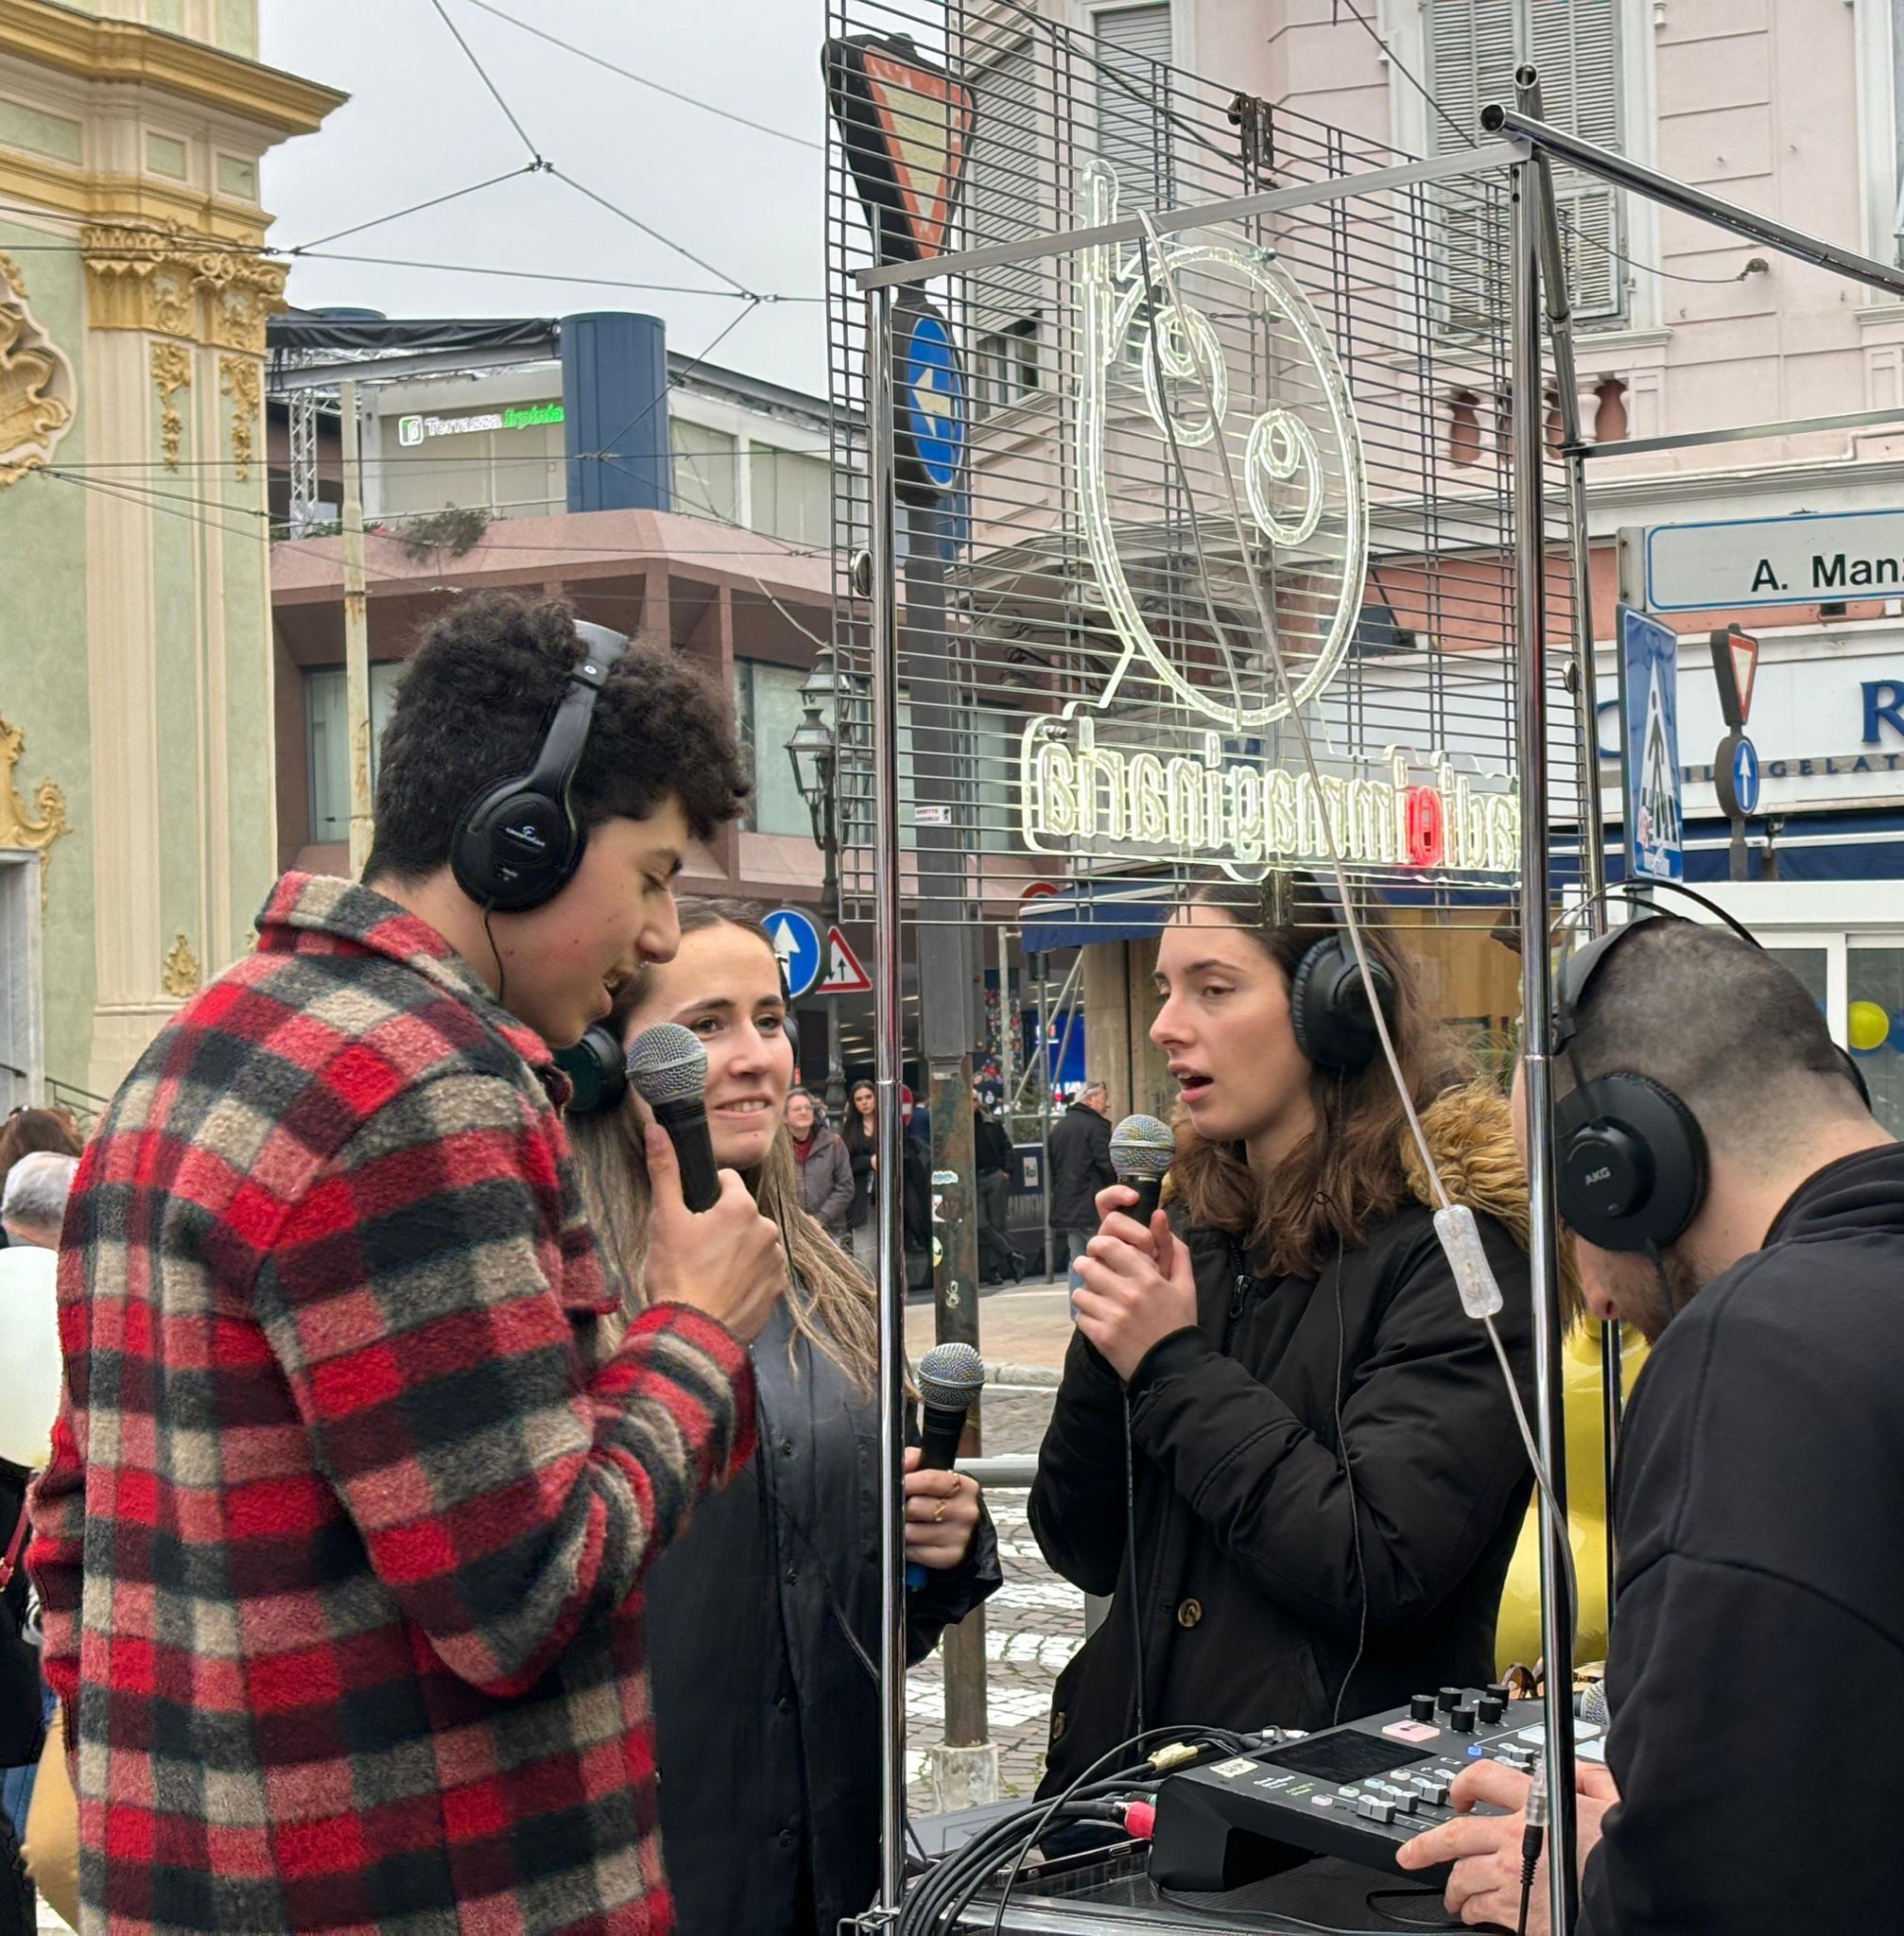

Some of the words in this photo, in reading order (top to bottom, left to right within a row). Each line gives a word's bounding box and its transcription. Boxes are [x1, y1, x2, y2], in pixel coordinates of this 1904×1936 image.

[425, 413, 502, 437] Terrazza
[1751, 559, 1788, 592] A.
[1812, 554, 1904, 588] Man
[1584, 1167, 1611, 1186] AKG
